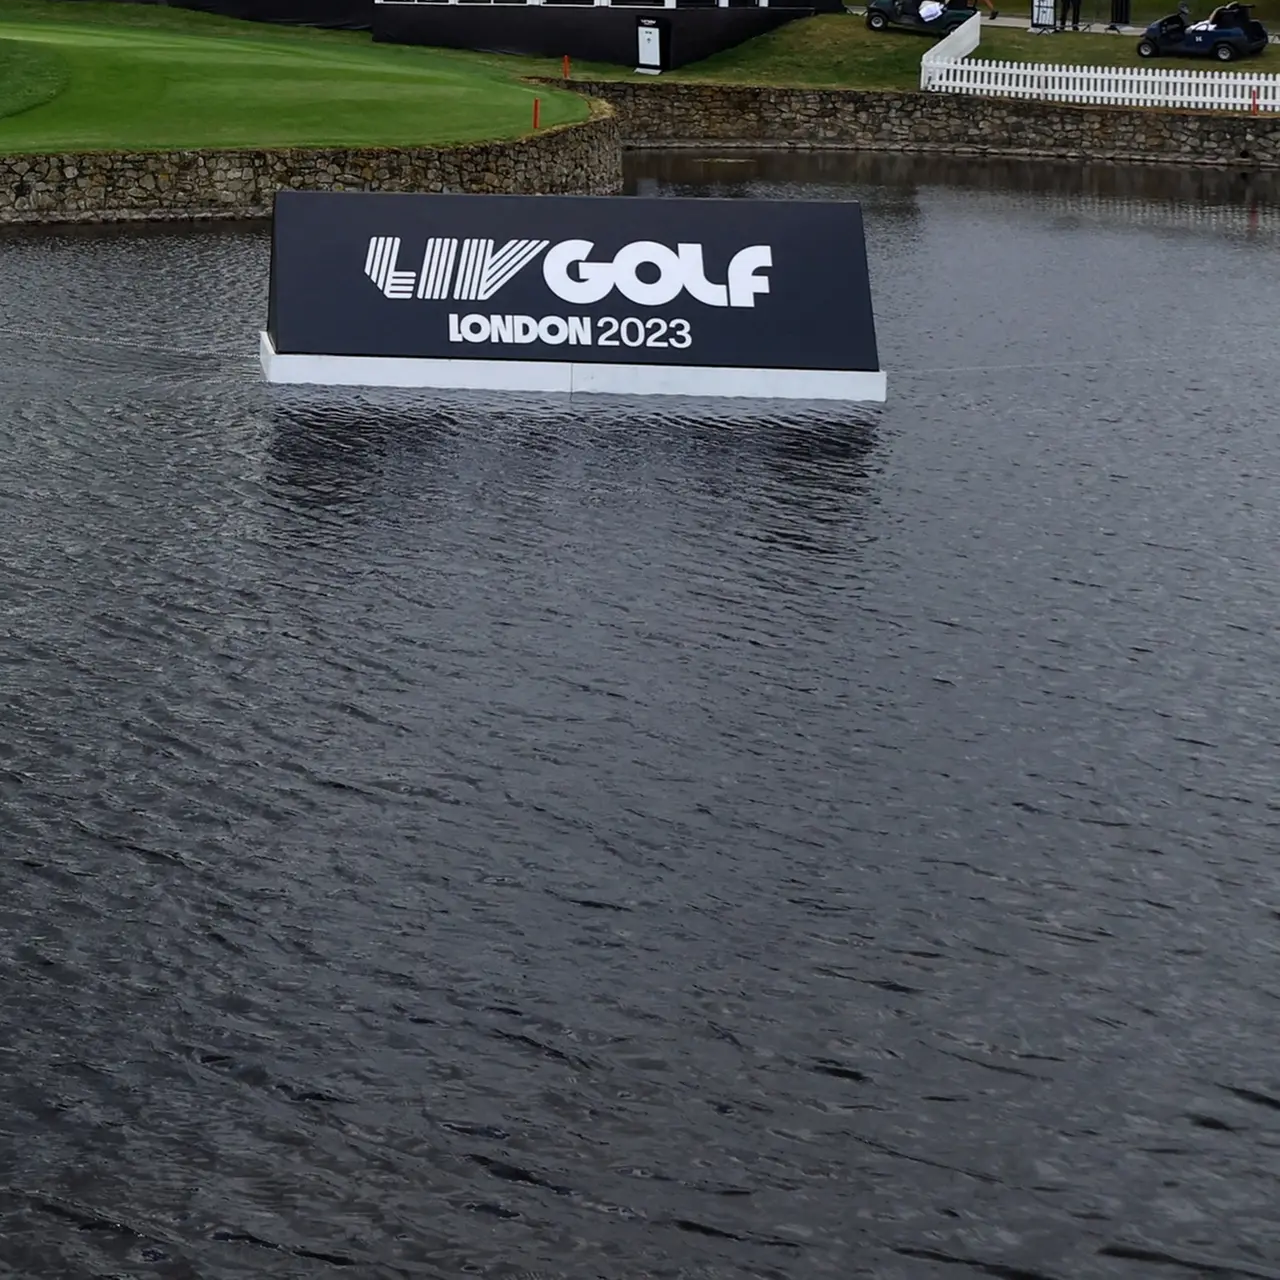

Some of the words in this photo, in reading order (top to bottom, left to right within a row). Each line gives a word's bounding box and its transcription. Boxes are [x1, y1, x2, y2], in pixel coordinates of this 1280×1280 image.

[364, 236, 550, 301] LIV
[542, 238, 773, 308] GOLF
[448, 313, 592, 346] LONDON
[596, 316, 693, 349] 2023
